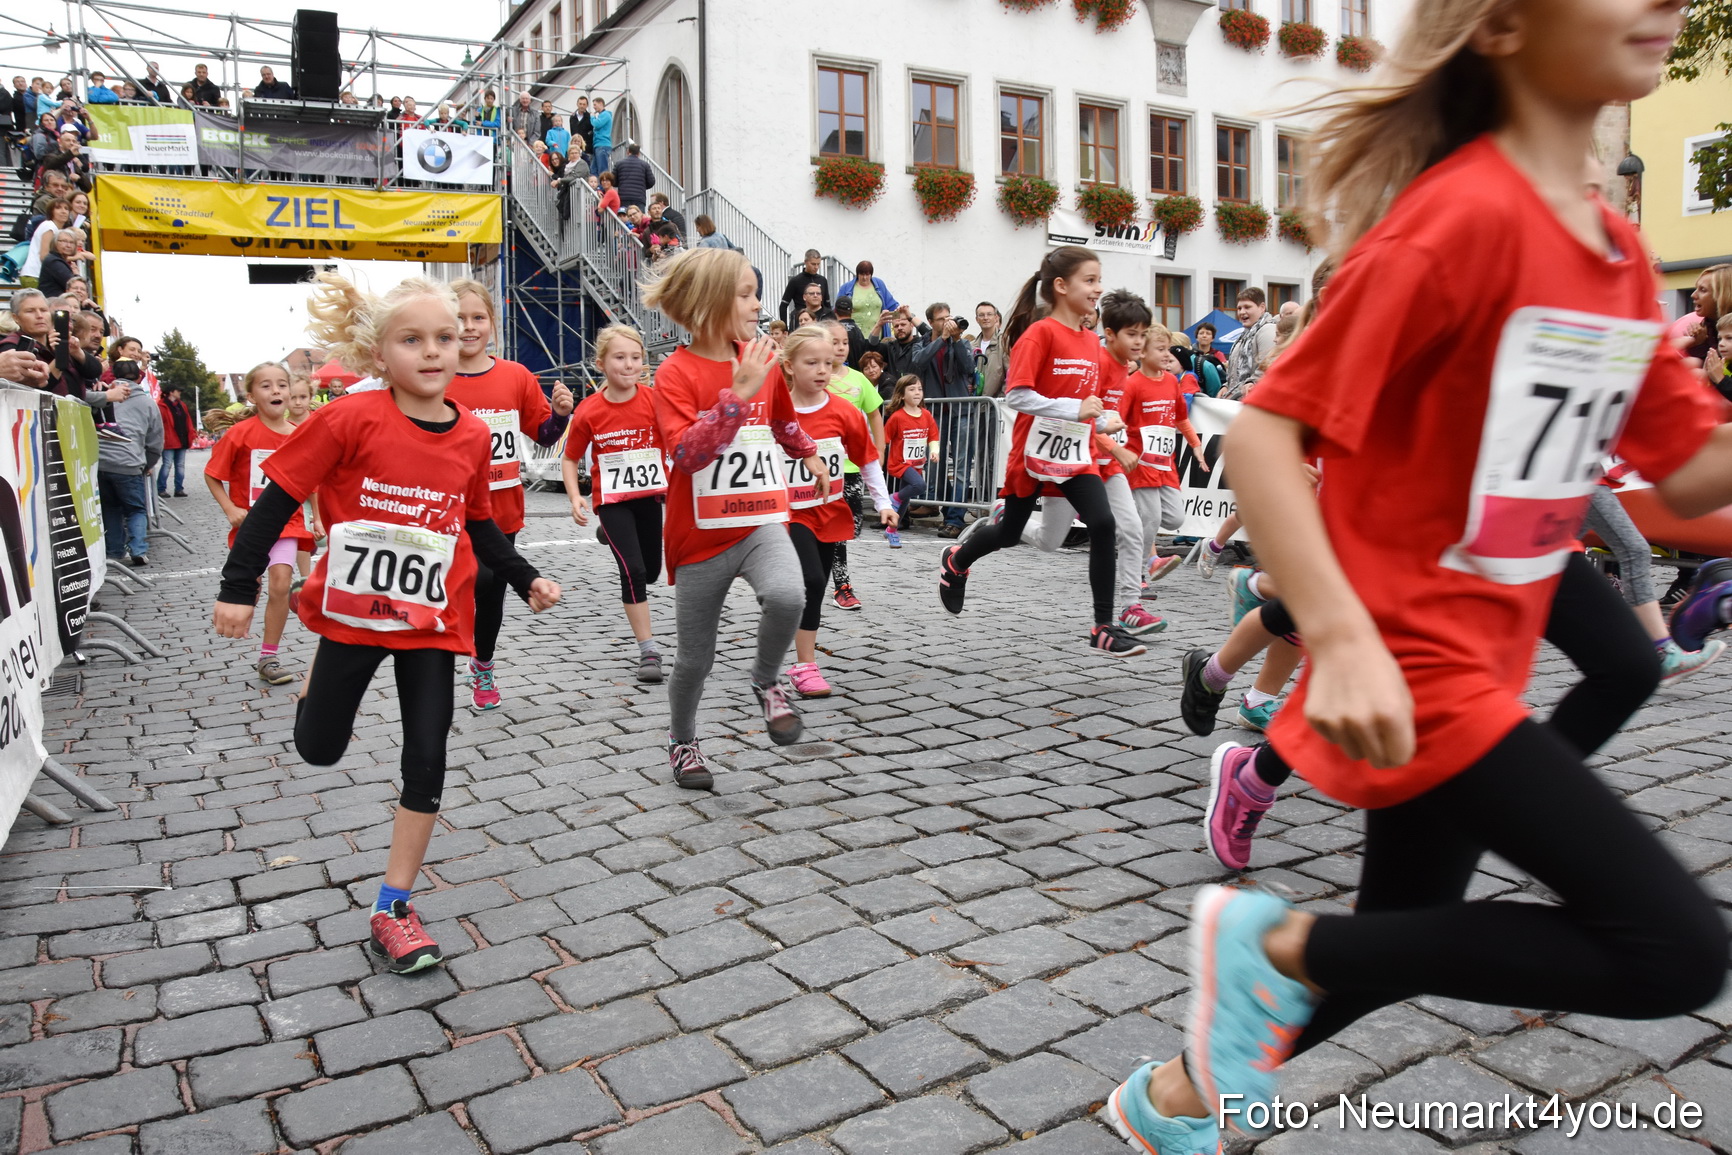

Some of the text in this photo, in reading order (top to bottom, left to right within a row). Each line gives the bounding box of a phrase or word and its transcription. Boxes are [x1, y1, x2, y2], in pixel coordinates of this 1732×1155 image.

[201, 129, 270, 147] BOCK
[420, 139, 450, 152] BMW
[294, 150, 375, 162] www.bockonline.de
[121, 204, 214, 218] Neumarkter Stadtlauf
[266, 196, 355, 229] ZIEL
[403, 219, 482, 227] Neumarkter Stadtlauf
[1094, 221, 1140, 240] swn
[1093, 238, 1124, 248] stadtwerke
[1124, 242, 1152, 250] neumarkt
[593, 429, 638, 441] Neumarkter
[598, 437, 629, 449] tadtlauf
[1035, 430, 1082, 461] 7081
[1148, 435, 1174, 454] 7153
[608, 463, 661, 490] 7432
[710, 450, 777, 490] 7241
[361, 476, 446, 502] Neumarkter
[359, 494, 427, 519] Stadtlauf
[721, 498, 777, 514] Johanna
[56, 546, 78, 560] Freizeit
[344, 544, 446, 603] 7060
[60, 578, 90, 594] Stadtbusse
